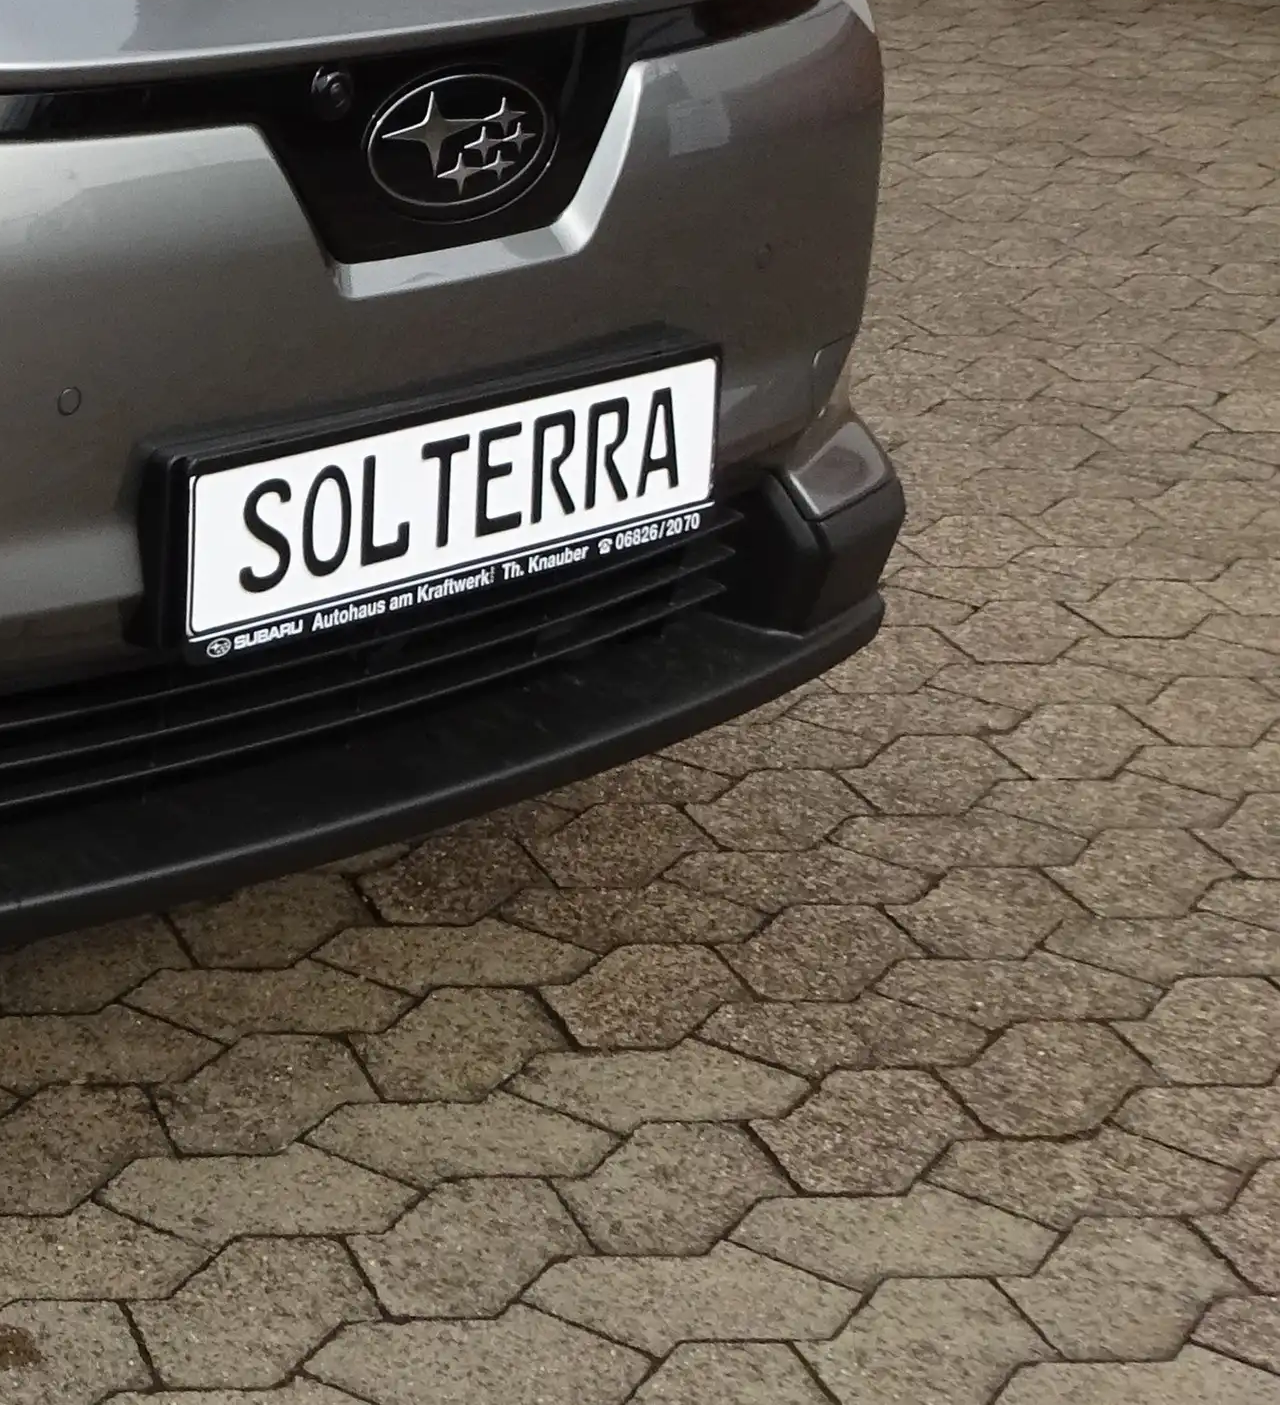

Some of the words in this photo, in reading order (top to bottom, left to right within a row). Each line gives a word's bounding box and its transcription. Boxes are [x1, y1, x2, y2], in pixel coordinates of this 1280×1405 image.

[234, 619, 304, 650] SUBARU
[312, 600, 385, 632] Autohaus
[389, 592, 414, 612] am
[417, 568, 491, 603] Kraftwerk
[502, 560, 525, 581] Th.
[528, 544, 590, 574] Knauber
